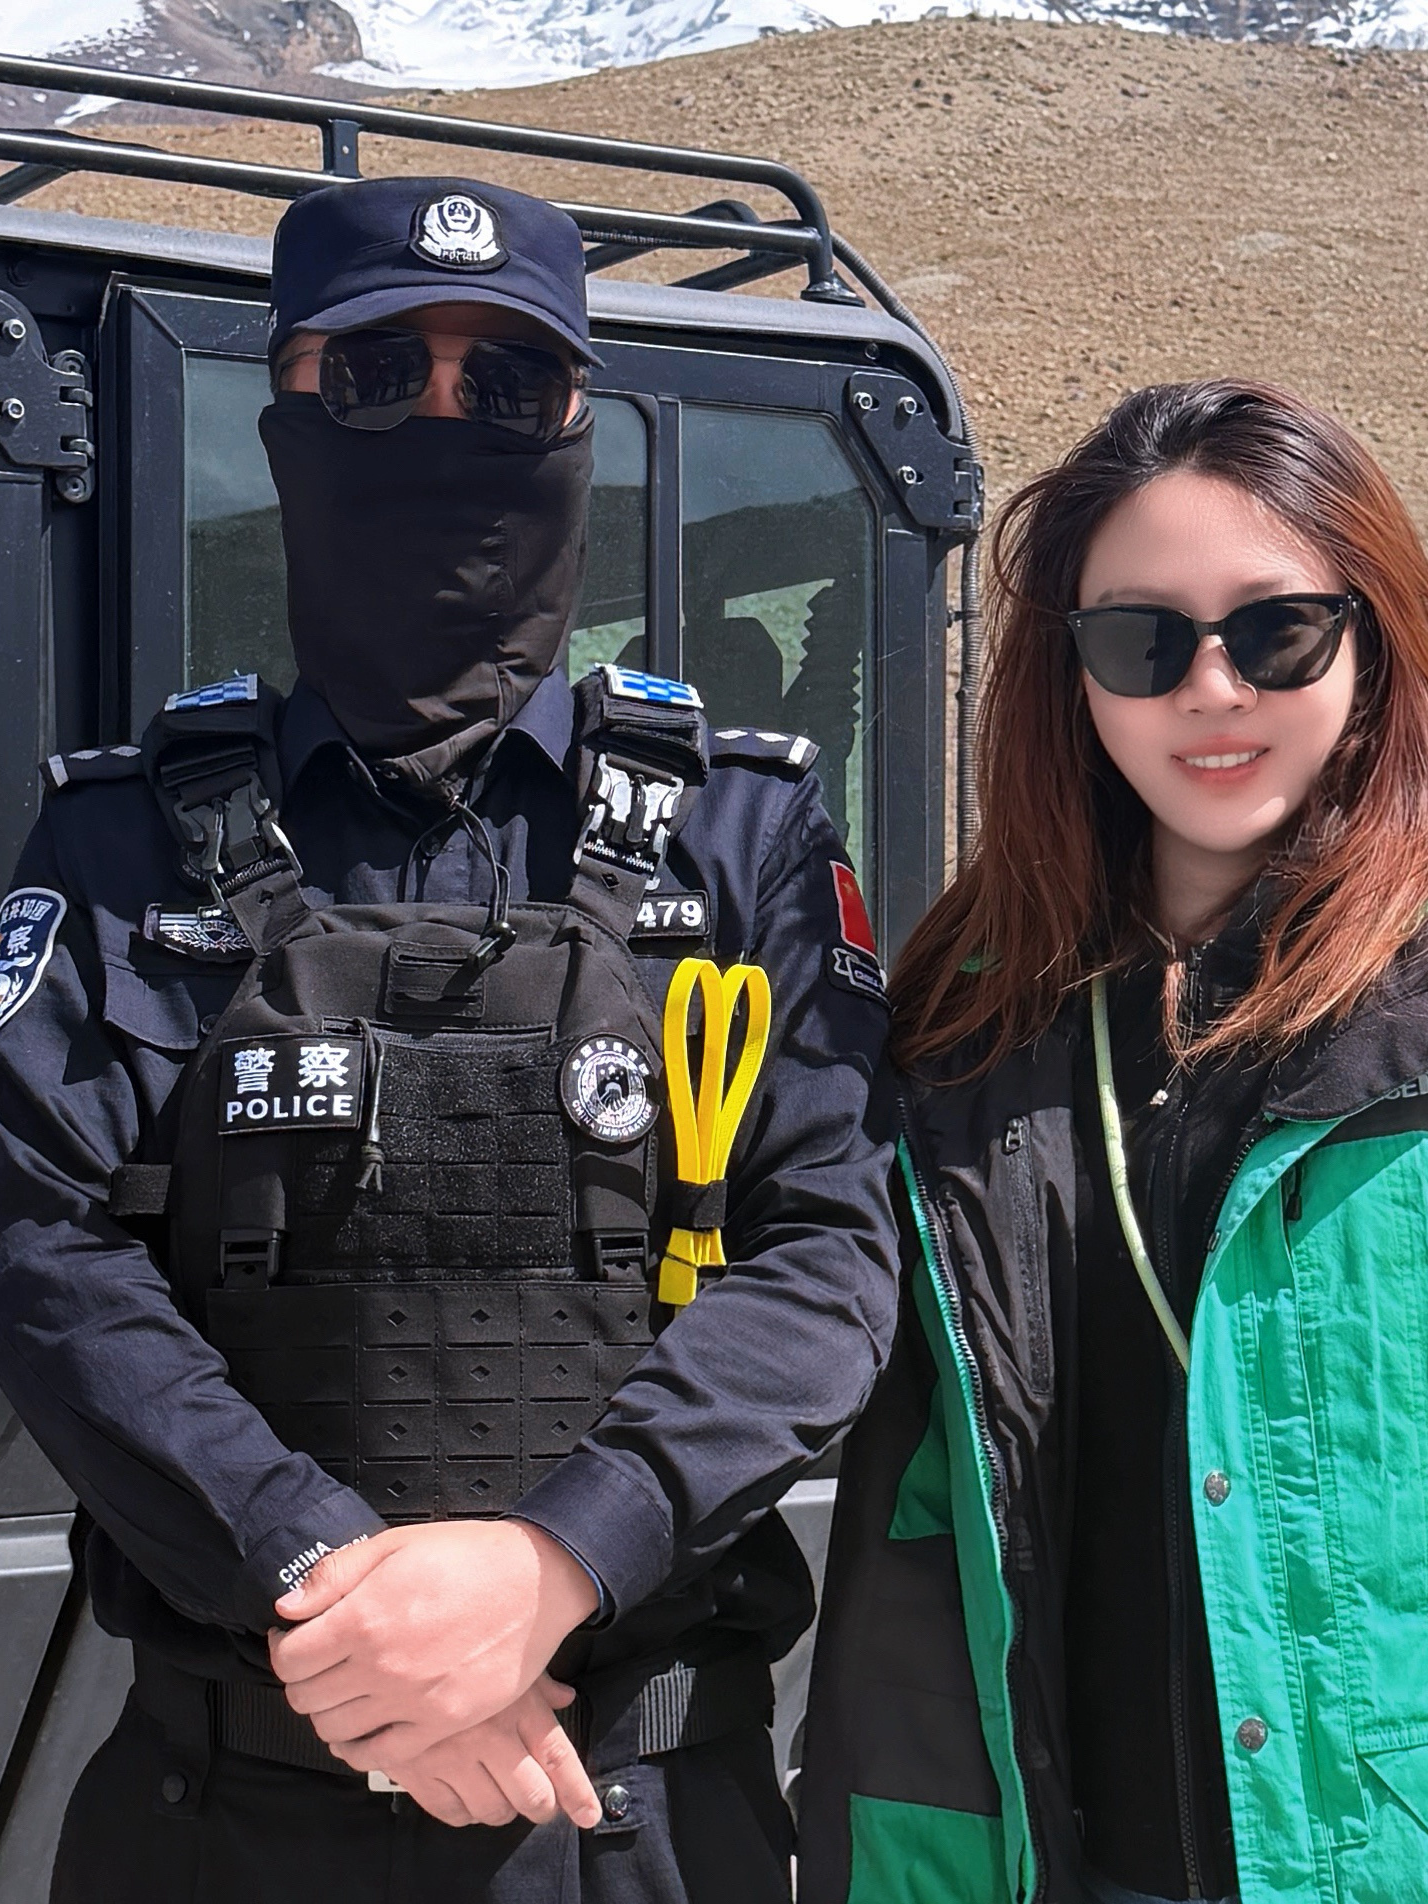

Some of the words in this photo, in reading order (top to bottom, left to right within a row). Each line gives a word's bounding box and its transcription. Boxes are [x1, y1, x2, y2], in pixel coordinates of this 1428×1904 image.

[234, 1042, 350, 1095] 警察
[226, 1094, 354, 1124] POLICE
[278, 1540, 334, 1585] CHINA
